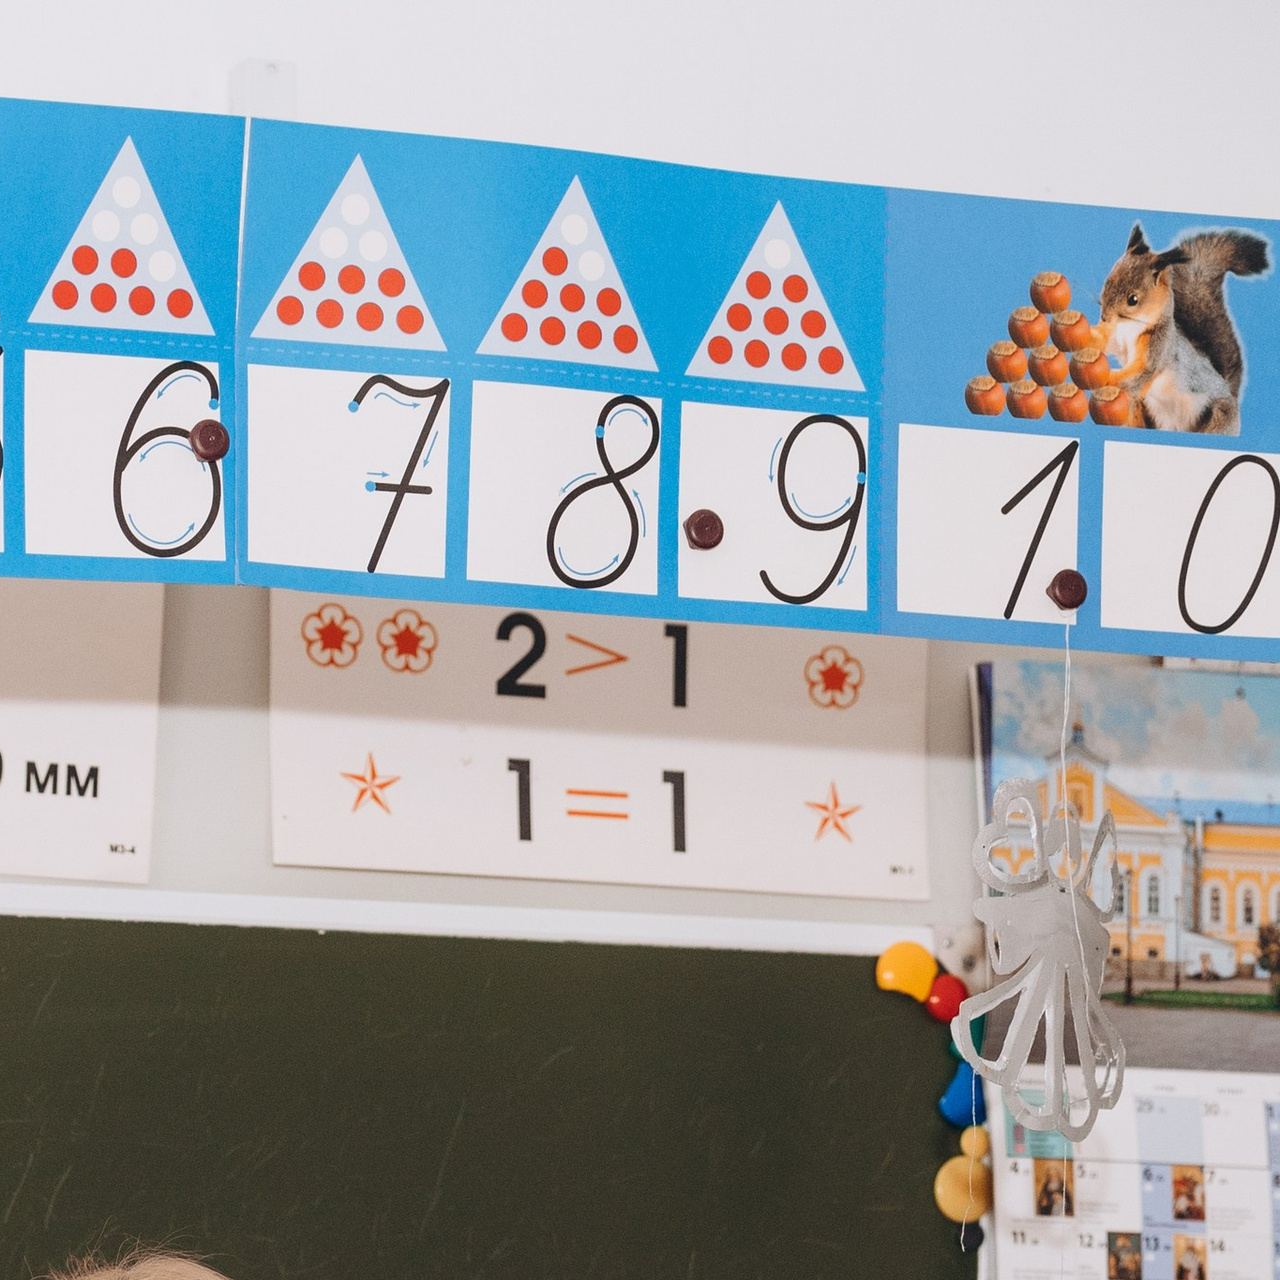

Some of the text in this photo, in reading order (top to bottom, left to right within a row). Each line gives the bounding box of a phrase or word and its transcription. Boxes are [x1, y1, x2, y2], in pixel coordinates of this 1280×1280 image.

[113, 360, 222, 558] 6
[348, 375, 451, 574] 7
[547, 394, 660, 590] 8
[759, 413, 868, 605] 9
[494, 610, 548, 700] 2
[663, 622, 688, 708] 1
[25, 761, 100, 798] мм
[507, 757, 687, 853] 1 = 1
